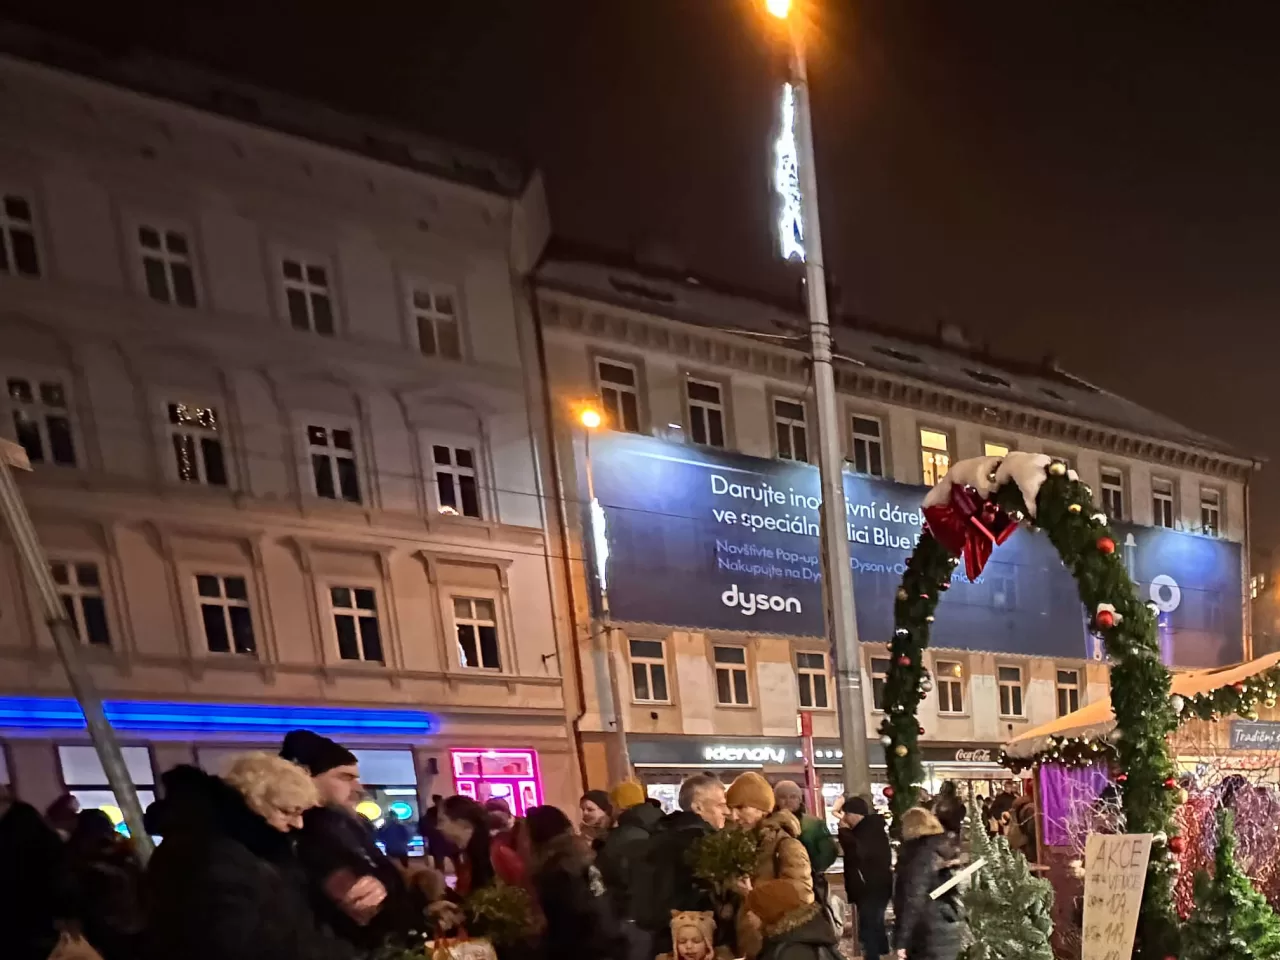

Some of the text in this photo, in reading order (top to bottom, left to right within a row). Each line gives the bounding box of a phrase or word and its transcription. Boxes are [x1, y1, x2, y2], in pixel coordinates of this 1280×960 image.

[710, 474, 786, 508] Darujte
[712, 509, 737, 525] ve
[741, 513, 820, 537] speciáln
[873, 530, 911, 549] Blue
[717, 557, 783, 579] Nakupujte
[785, 568, 801, 580] na
[776, 548, 819, 565] Pop-up
[851, 557, 885, 574] Dyson
[886, 565, 893, 574] v
[721, 584, 802, 616] dyson
[1091, 839, 1143, 870] AKCE
